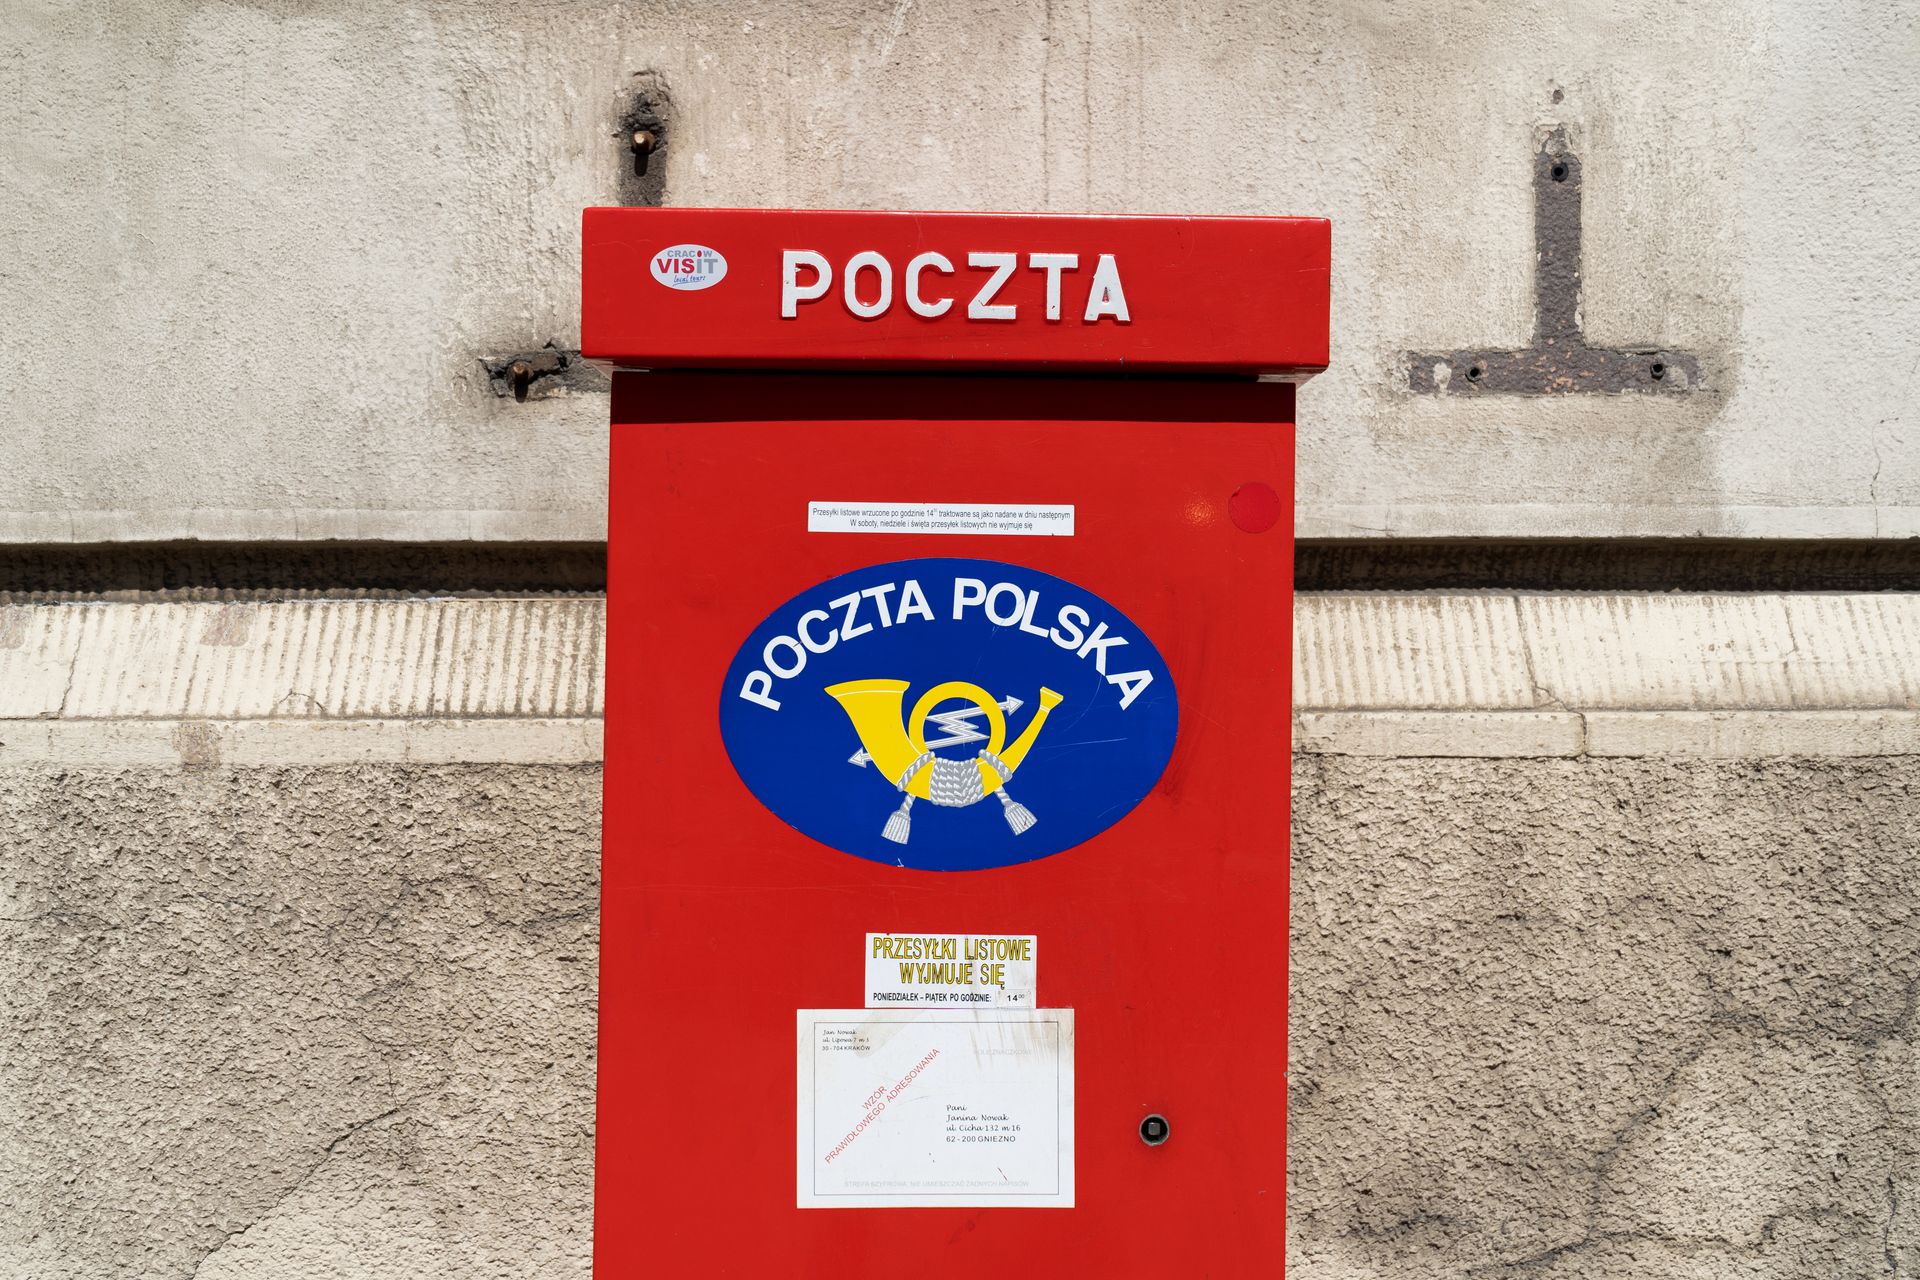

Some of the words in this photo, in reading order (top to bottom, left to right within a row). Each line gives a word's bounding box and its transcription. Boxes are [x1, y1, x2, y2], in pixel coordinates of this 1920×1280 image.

[657, 258, 718, 274] VISIT
[781, 249, 1131, 322] POCZTA
[812, 508, 838, 518] Przesyłki
[840, 508, 860, 517] listowe
[891, 511, 899, 519] po
[900, 509, 925, 518] godzinie
[939, 510, 971, 518] traktowane
[972, 511, 981, 519] są
[981, 510, 994, 520] jako
[994, 510, 1017, 518] nadane
[1024, 510, 1038, 519] dniu
[1039, 511, 1071, 520] następnym
[850, 519, 856, 527] W
[858, 519, 879, 529] soboty,
[880, 519, 907, 528] niedziele
[911, 519, 930, 529] święta
[931, 520, 959, 530] przesyłek
[960, 520, 988, 530] listowych
[988, 521, 998, 529] nie
[999, 521, 1023, 530] wyjmuje
[1024, 521, 1033, 530] się
[739, 579, 935, 712] POCZTA
[952, 577, 1154, 710] POLSKA
[872, 937, 957, 960] PRZESYŁKI
[964, 938, 1031, 961] LISTOWE
[899, 962, 973, 985] WYJMUJE
[980, 963, 1006, 990] SIĘ
[873, 992, 919, 1001] PONIEDZIAŁEK
[925, 993, 948, 1003] PIĄTEK
[950, 993, 960, 1002] PO
[824, 1102, 886, 1164] PRAWIDŁOWEGO
[886, 1048, 940, 1102] ADRESOWANIA
[862, 1085, 887, 1110] WZÓR
[945, 1114, 978, 1122] Janina
[981, 1113, 1010, 1121] Nowak
[959, 1123, 983, 1131] Cicha
